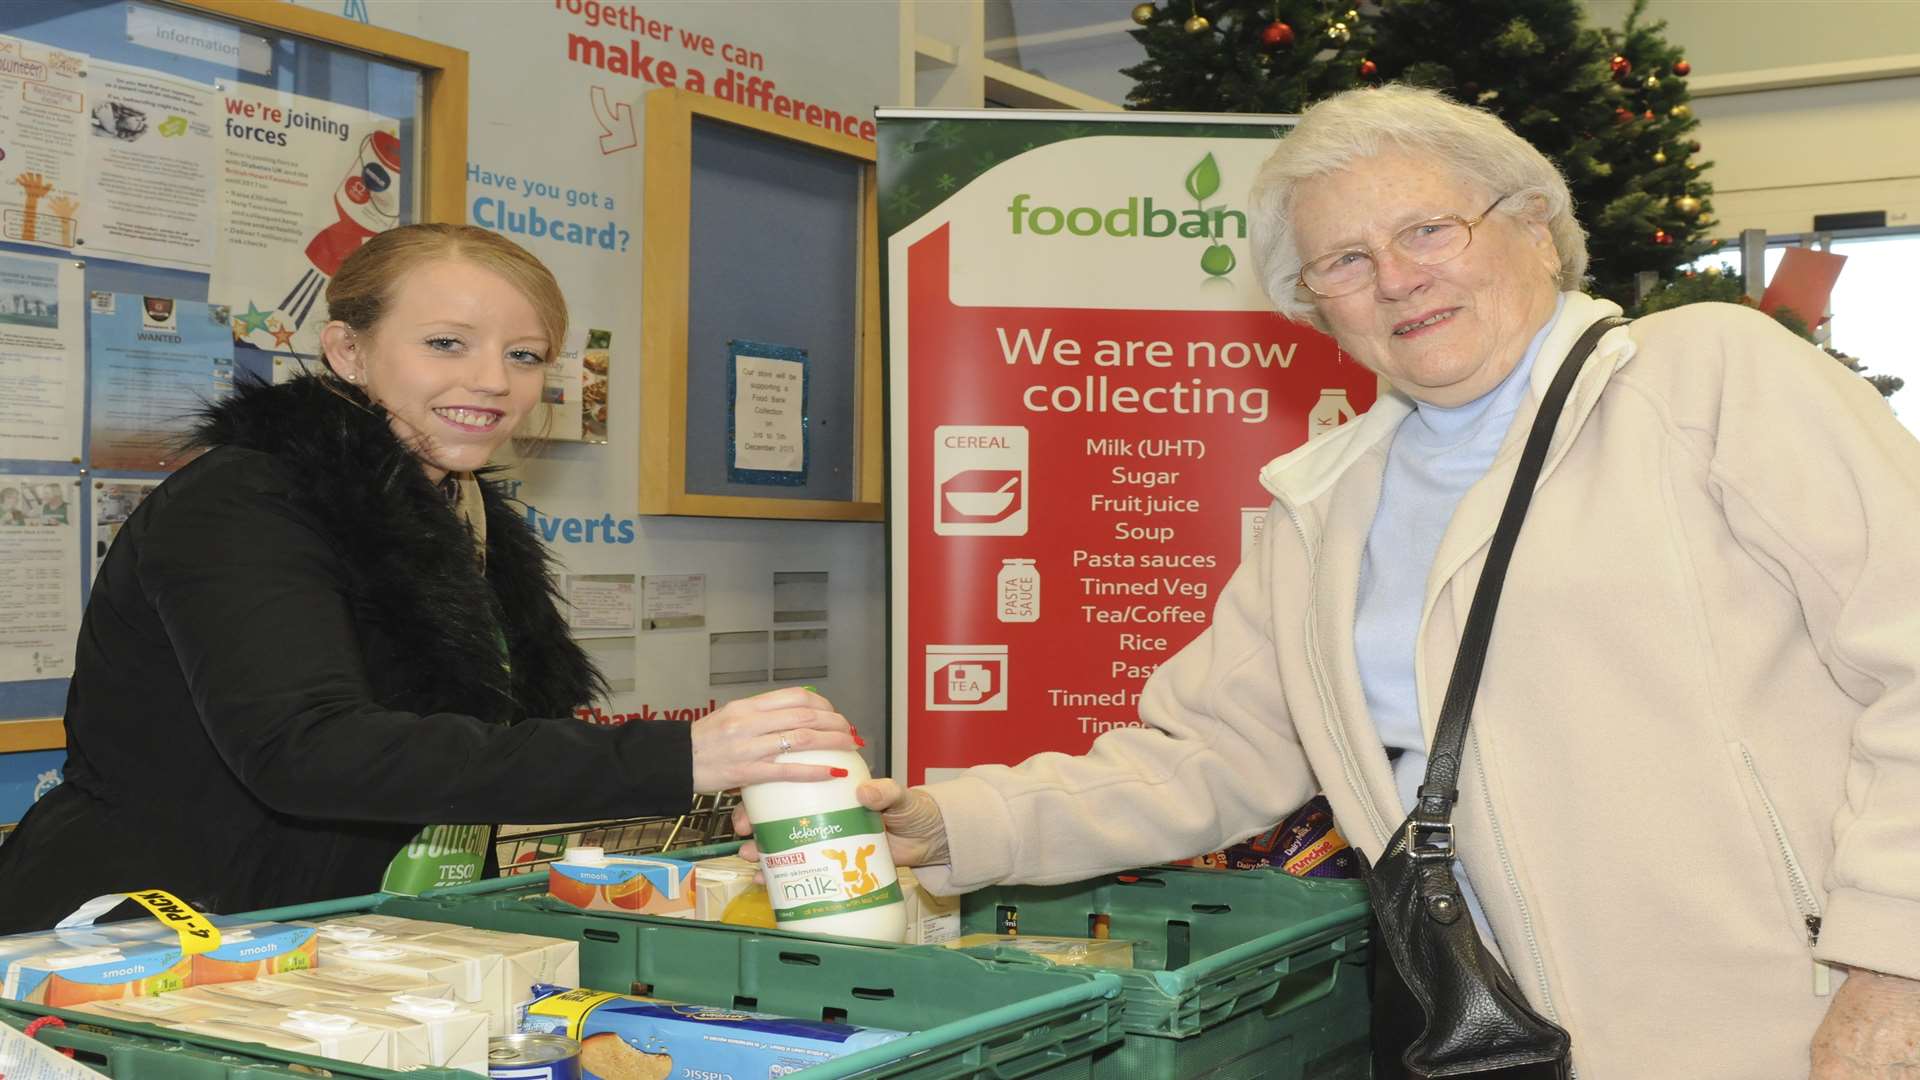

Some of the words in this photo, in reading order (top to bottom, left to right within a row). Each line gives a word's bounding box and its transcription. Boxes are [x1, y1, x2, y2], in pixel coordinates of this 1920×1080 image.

[680, 28, 715, 56] we
[721, 43, 764, 71] can
[567, 32, 677, 88] make
[684, 68, 705, 94] a
[713, 68, 876, 142] difference
[225, 97, 282, 123] We're
[285, 108, 350, 142] joining
[225, 118, 288, 147] forces
[466, 162, 517, 191] Have
[523, 178, 560, 199] you
[566, 189, 599, 208] got
[604, 196, 615, 210] a
[472, 196, 630, 252] Clubcard?
[1007, 193, 1247, 239] foodban
[137, 332, 182, 345] WANTED
[996, 328, 1082, 366] We
[1094, 338, 1174, 367] are
[1187, 340, 1298, 368] now
[1023, 375, 1269, 424] collecting
[944, 435, 1010, 449] CEREAL
[1086, 438, 1133, 456] Milk
[1138, 439, 1206, 459] (UHT)
[1112, 466, 1180, 488] Sugar
[1091, 494, 1142, 512] Fruit
[1144, 496, 1200, 516] juice
[1114, 522, 1175, 544] Soup
[1073, 550, 1135, 568] Pasta
[1140, 554, 1217, 568] sauces
[1004, 577, 1018, 617] PASTA
[1019, 576, 1033, 617] SAUCE
[1080, 578, 1158, 596] Tinned
[1162, 578, 1208, 600] Veg
[1081, 605, 1206, 623] Tea/Coffee
[1119, 633, 1167, 651] Rice
[1112, 661, 1160, 679] Past
[950, 680, 980, 692] TEA
[1048, 688, 1126, 707] Tinned
[1077, 716, 1151, 734] Tinne
[1284, 839, 1302, 856] Dairy
[440, 863, 475, 880] TESCO
[580, 872, 608, 881] smooth
[1237, 860, 1256, 872] Dairy
[783, 876, 837, 900] milk
[239, 943, 278, 957] smooth
[103, 964, 145, 979] smooth
